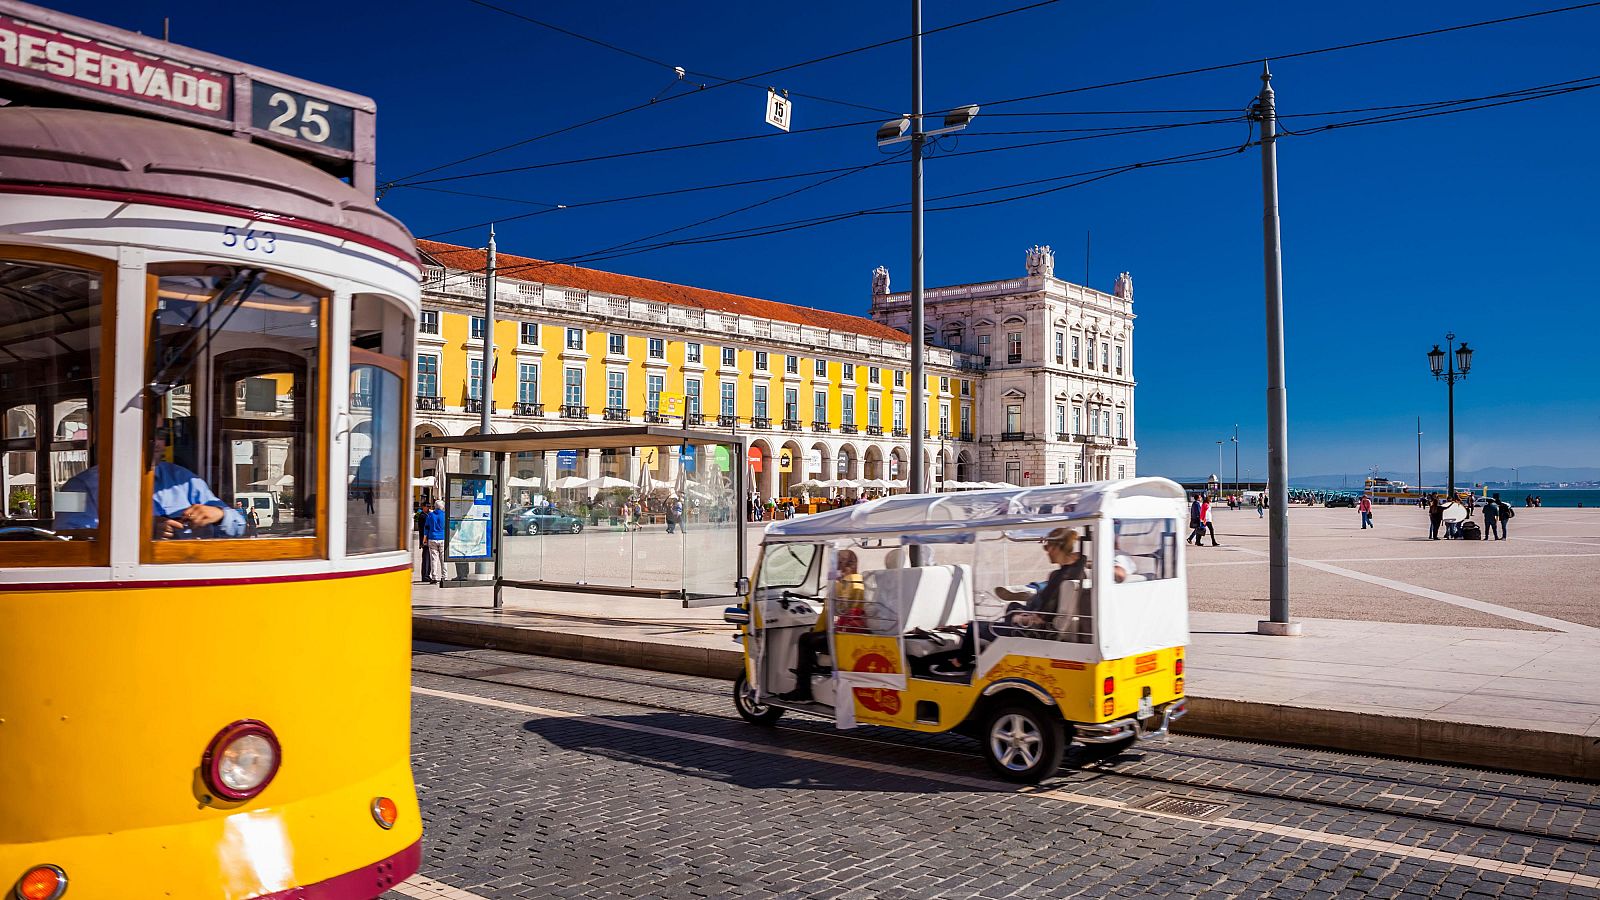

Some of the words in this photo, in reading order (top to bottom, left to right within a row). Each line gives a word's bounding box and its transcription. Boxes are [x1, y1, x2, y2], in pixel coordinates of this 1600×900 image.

[0, 28, 222, 112] RESERVADO
[268, 92, 330, 143] 25
[774, 102, 784, 117] 15
[222, 226, 277, 253] 563
